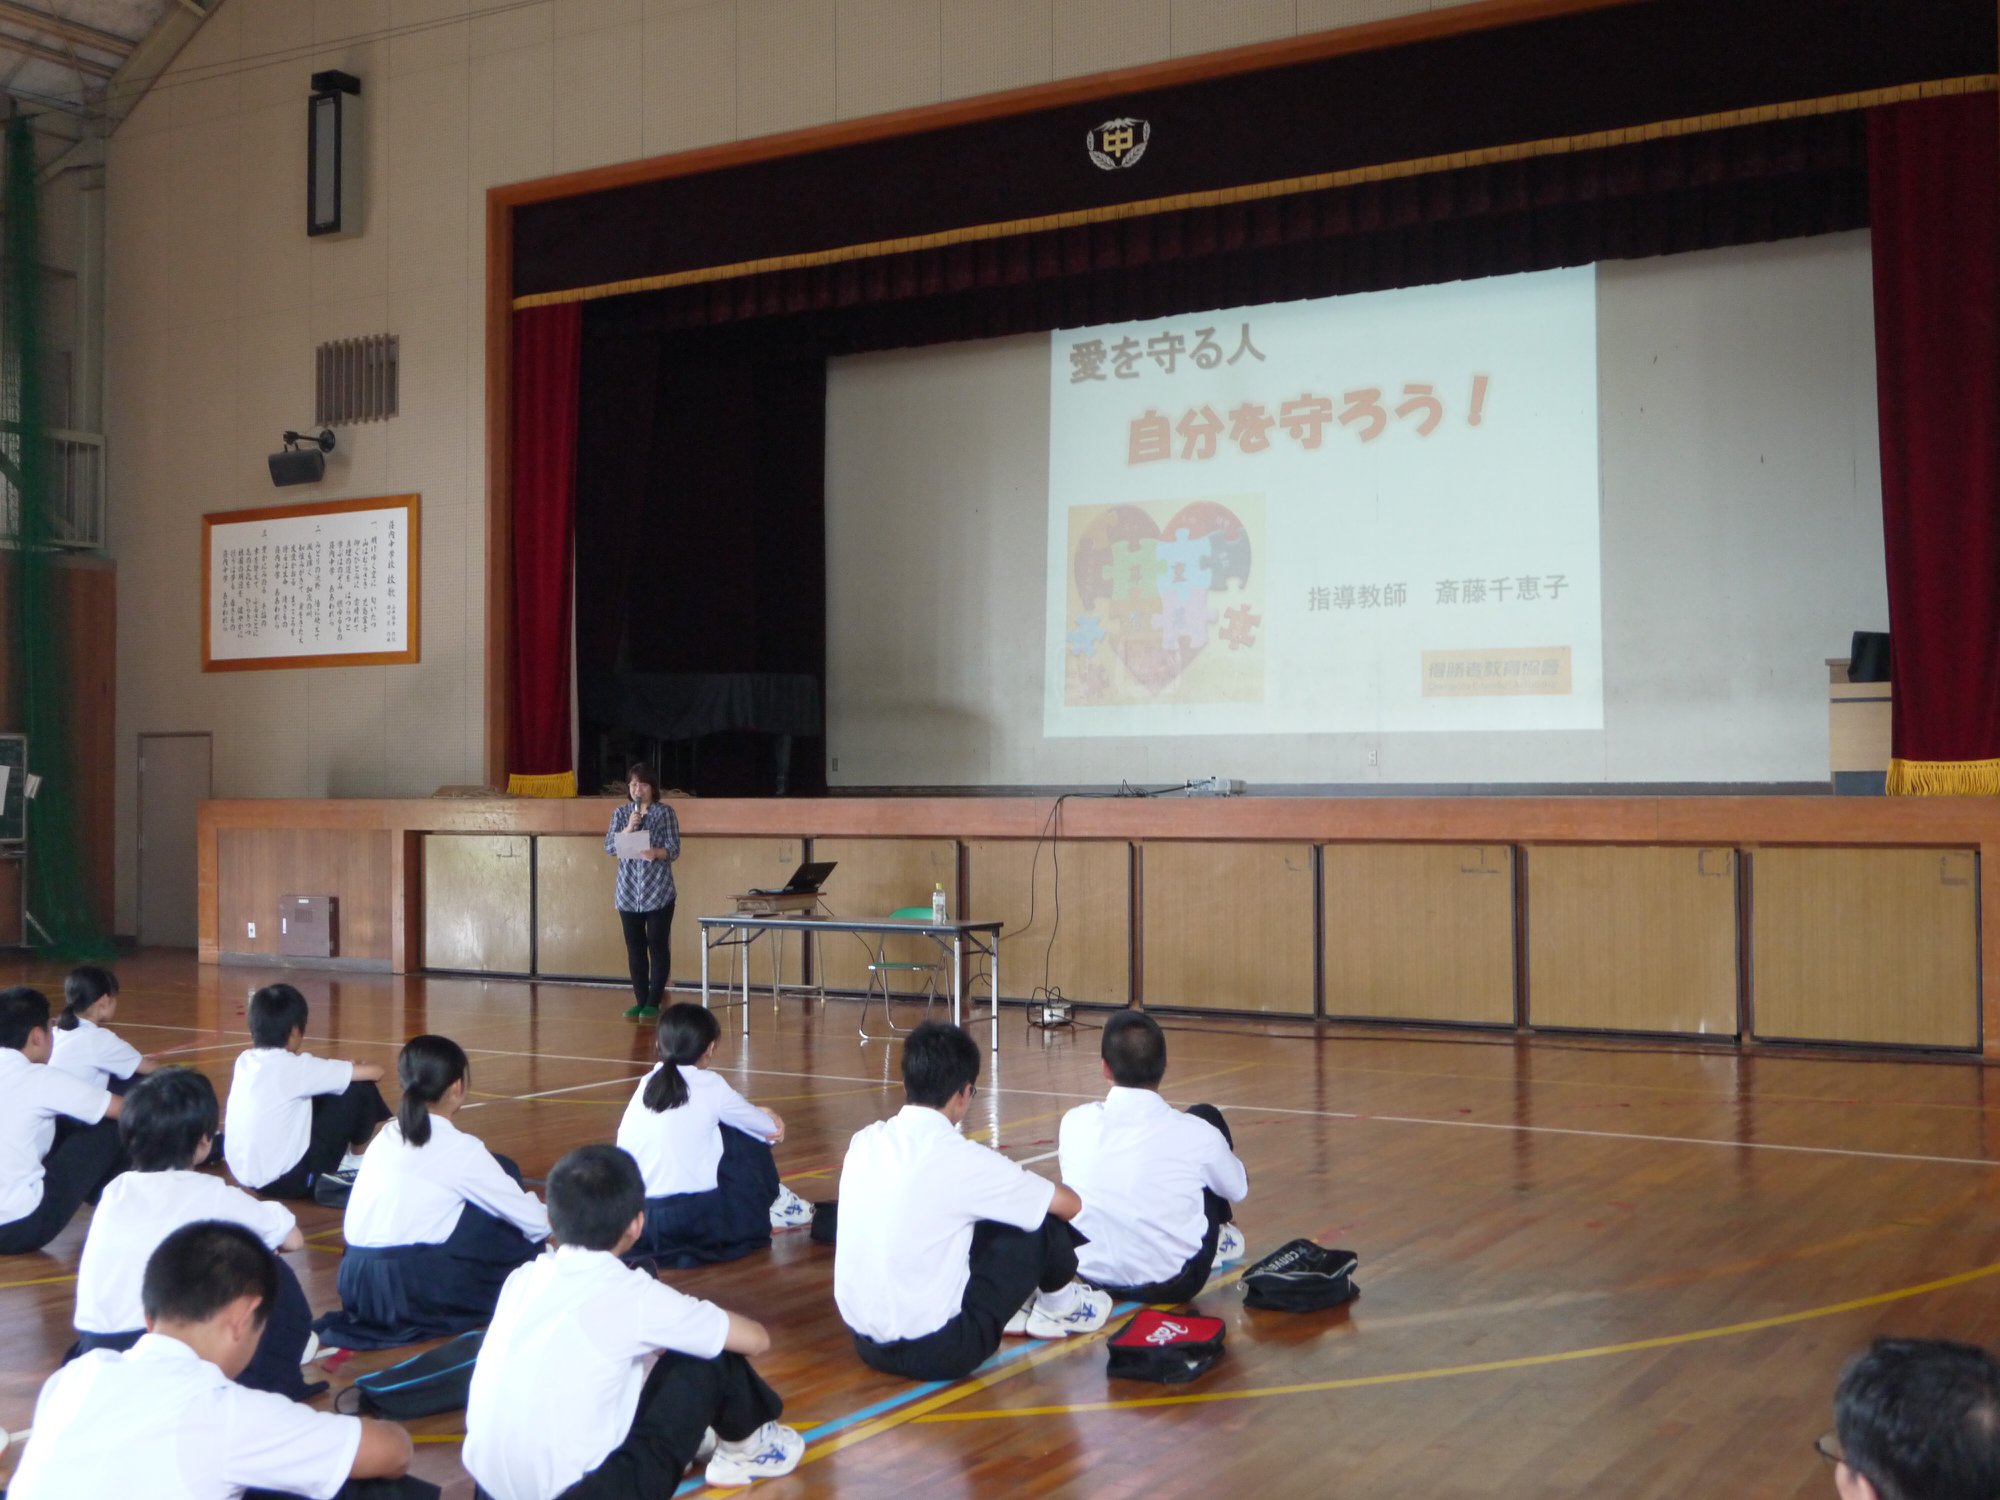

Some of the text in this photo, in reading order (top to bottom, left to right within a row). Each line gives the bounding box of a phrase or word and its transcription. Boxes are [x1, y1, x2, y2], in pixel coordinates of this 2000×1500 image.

[1069, 323, 1267, 384] 愛を守る人
[1127, 374, 1490, 466] 自分を守ろう！
[1308, 582, 1407, 611] 指導教師
